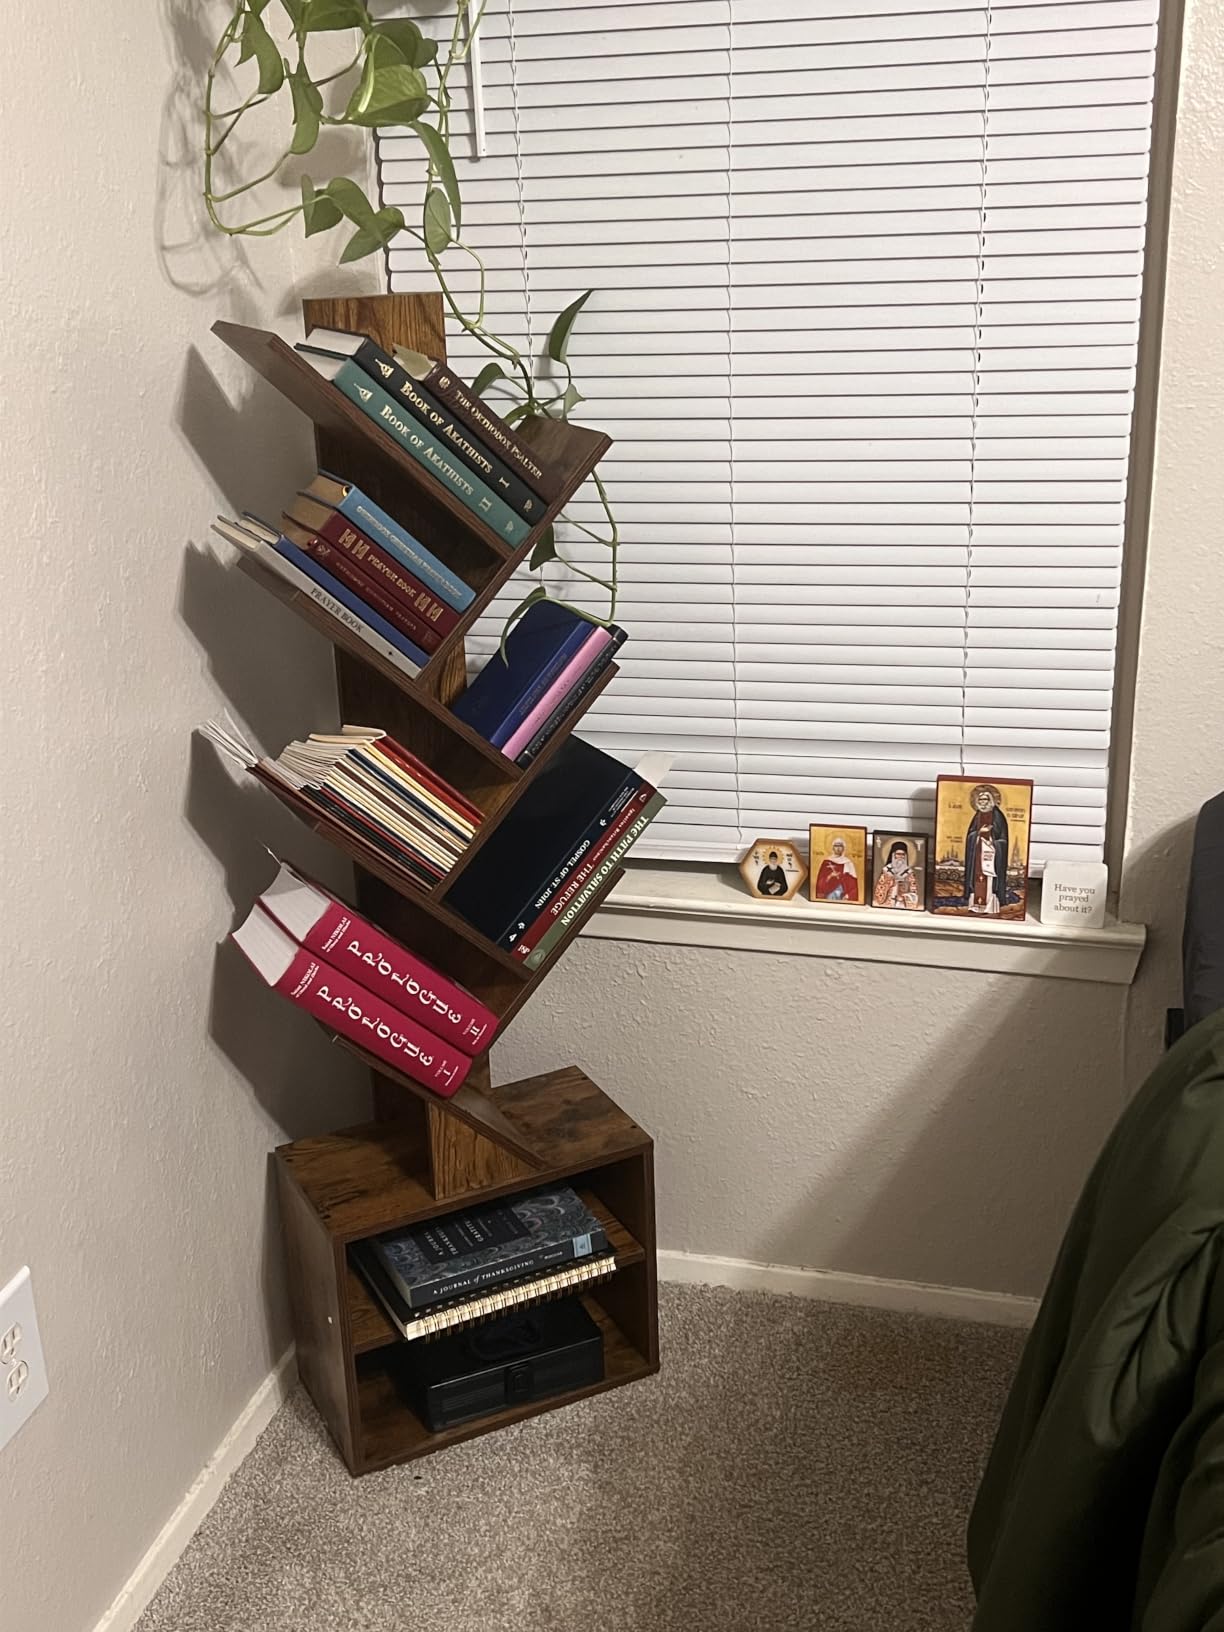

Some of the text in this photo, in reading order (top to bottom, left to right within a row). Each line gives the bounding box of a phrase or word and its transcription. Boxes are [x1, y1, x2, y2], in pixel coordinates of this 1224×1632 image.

[399, 381, 430, 413] BOOK
[429, 412, 443, 425] OF
[442, 422, 493, 473] AKATHISTS
[453, 391, 542, 478] THE ORTHODOX PSALTER
[380, 405, 409, 436] BOOK
[409, 435, 423, 448] OF
[422, 445, 473, 495] AKATHISTS
[367, 555, 396, 581] PRAYER
[395, 578, 416, 597] BOOK
[310, 588, 363, 632] PRAYER BOOK
[630, 814, 648, 835] THE
[566, 839, 590, 867] GOSPEL
[610, 834, 632, 860] PATH
[559, 866, 568, 878] OF
[575, 862, 593, 882] THE
[600, 859, 613, 873] TO
[534, 887, 552, 908] JOHN
[550, 881, 578, 915] REFUGE
[560, 873, 602, 924] SALVATION
[1054, 883, 1096, 896] Have you
[1058, 894, 1089, 904] prayed
[1054, 902, 1093, 913] about it?
[348, 940, 462, 1023] PROLOGUE
[317, 985, 433, 1066] PROLOGUE
[470, 1025, 479, 1035] II
[440, 1280, 469, 1292] JOURNAL
[482, 1260, 533, 1278] THANKSGIVING
